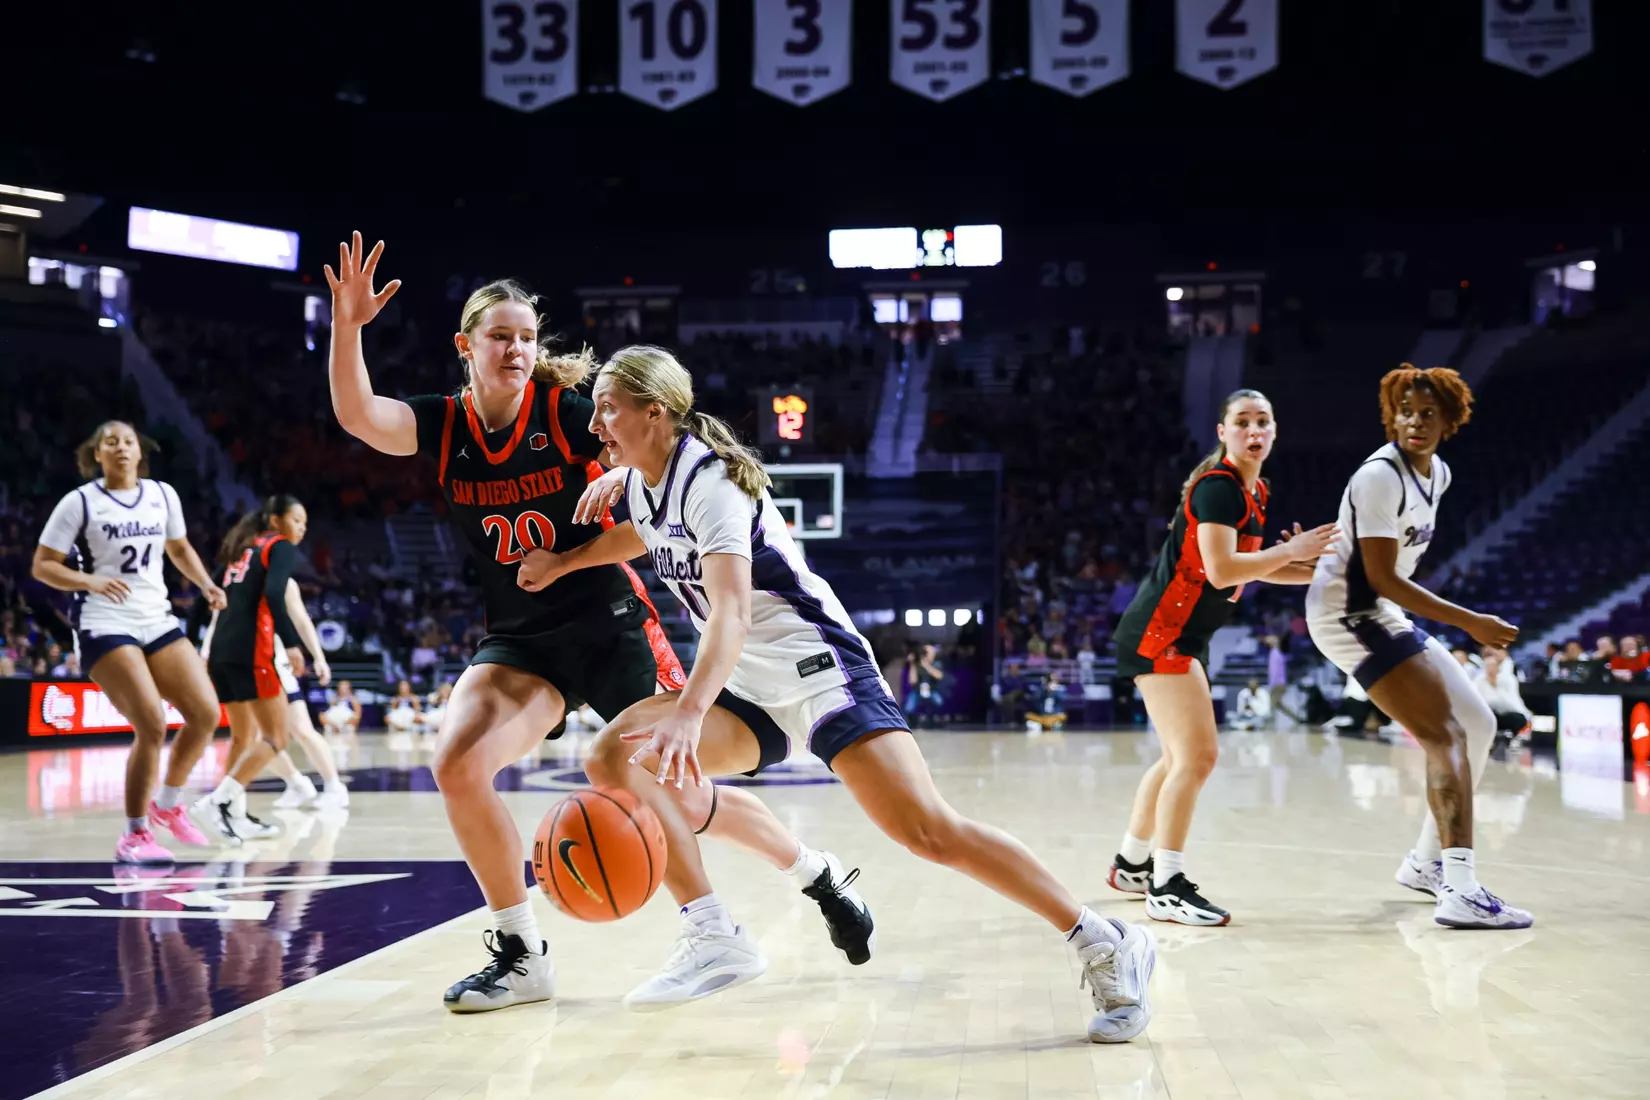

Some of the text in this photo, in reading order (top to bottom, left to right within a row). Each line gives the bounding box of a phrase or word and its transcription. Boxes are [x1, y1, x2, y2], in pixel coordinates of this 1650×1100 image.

[490, 2, 569, 65] 33
[628, 0, 708, 61] 10
[784, 0, 823, 56] 3
[899, 0, 981, 51] 53
[1060, 0, 1100, 46] 5
[1206, 0, 1249, 39] 2
[1038, 260, 1088, 287] 26
[1362, 251, 1408, 279] 27
[452, 466, 564, 506] SAN DIEGO STATE
[482, 510, 556, 565] 20
[120, 544, 152, 574] 24
[649, 547, 703, 581] Wildcat
[821, 656, 830, 665] M
